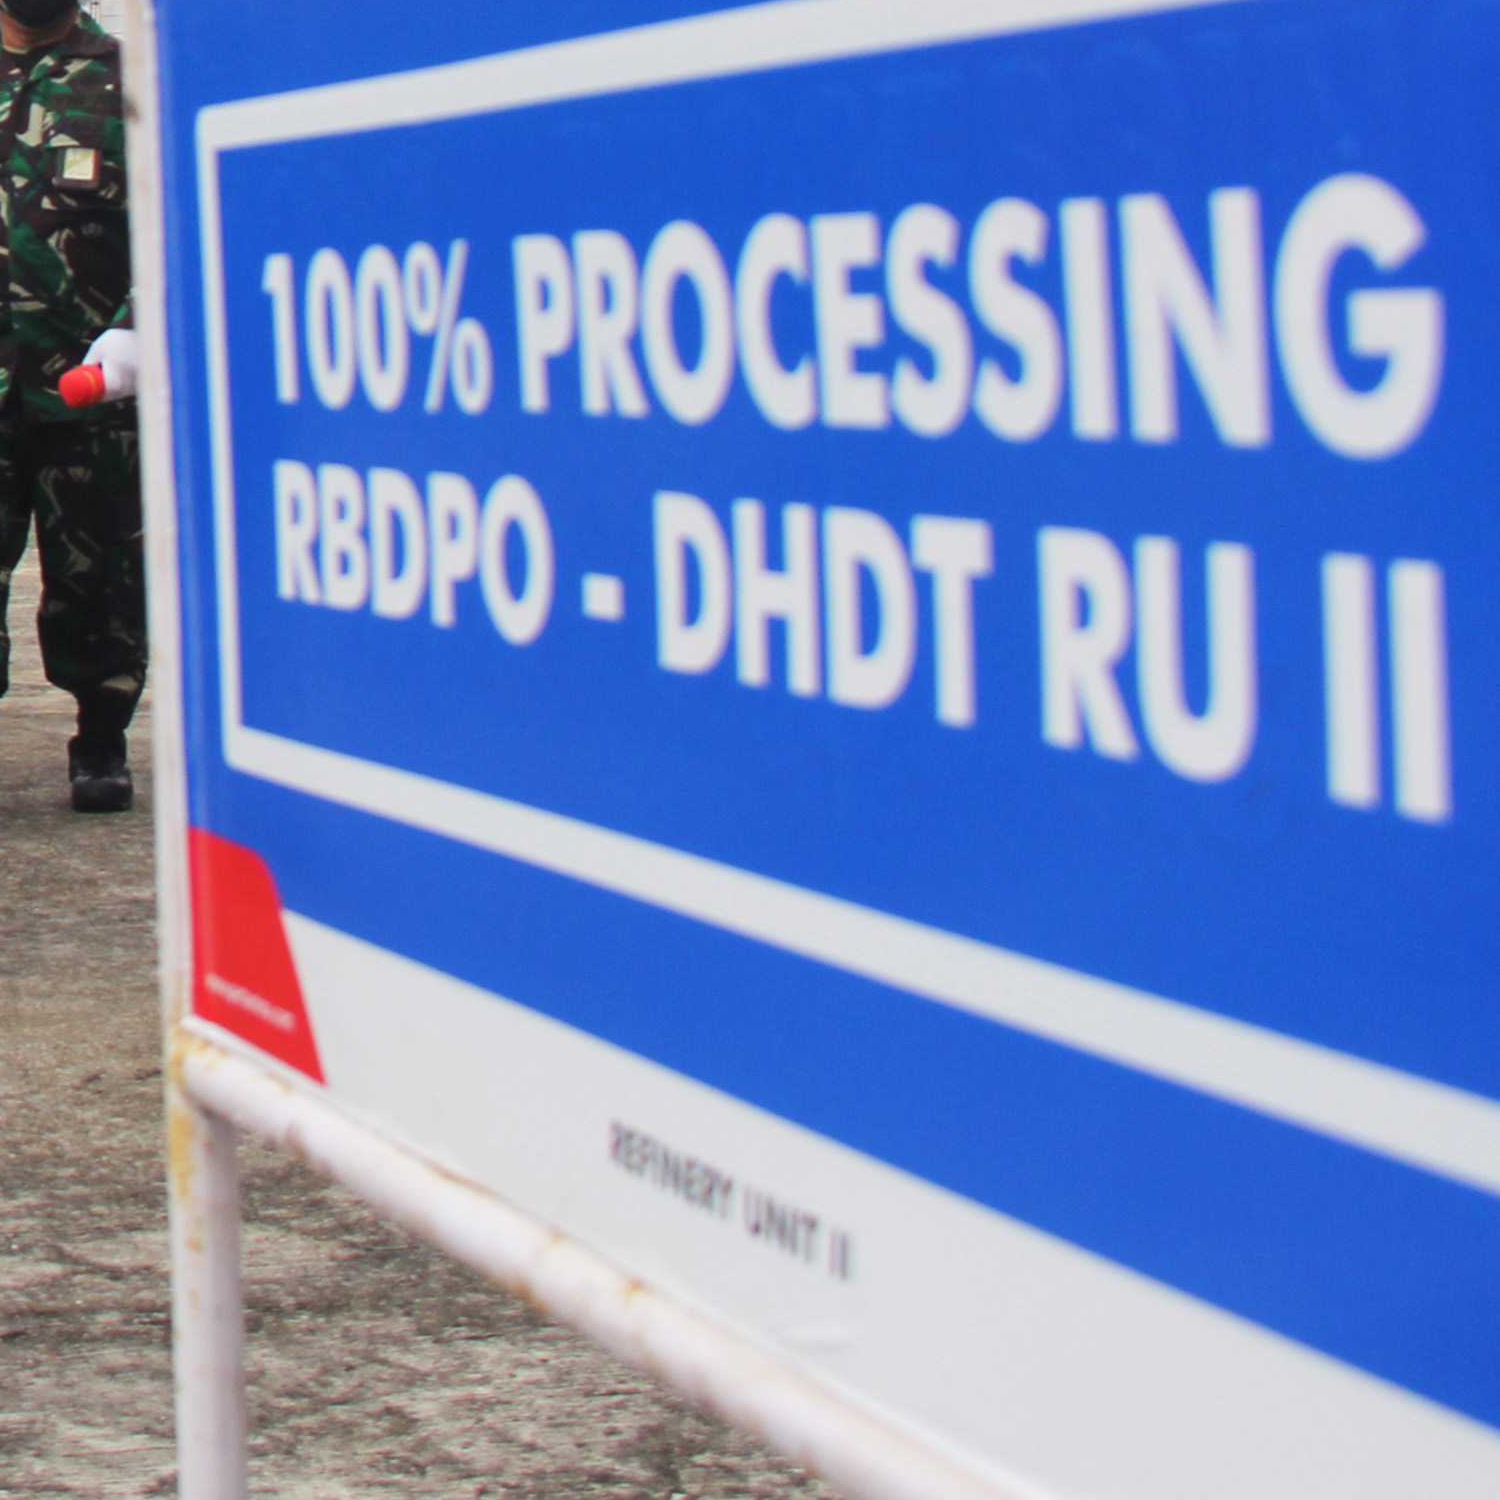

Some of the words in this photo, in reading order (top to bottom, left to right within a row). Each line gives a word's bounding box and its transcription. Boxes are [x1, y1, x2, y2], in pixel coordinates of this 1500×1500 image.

[262, 237, 492, 415] 100%
[512, 172, 1443, 459] PROCESSING
[273, 457, 553, 644] RBDPO
[581, 571, 624, 621] -
[652, 489, 993, 729] DHDT
[1037, 523, 1256, 783] RU
[1321, 550, 1451, 824] II
[608, 1116, 733, 1220] REFINERY
[743, 1182, 819, 1263] UNIT
[828, 1225, 850, 1281] II
